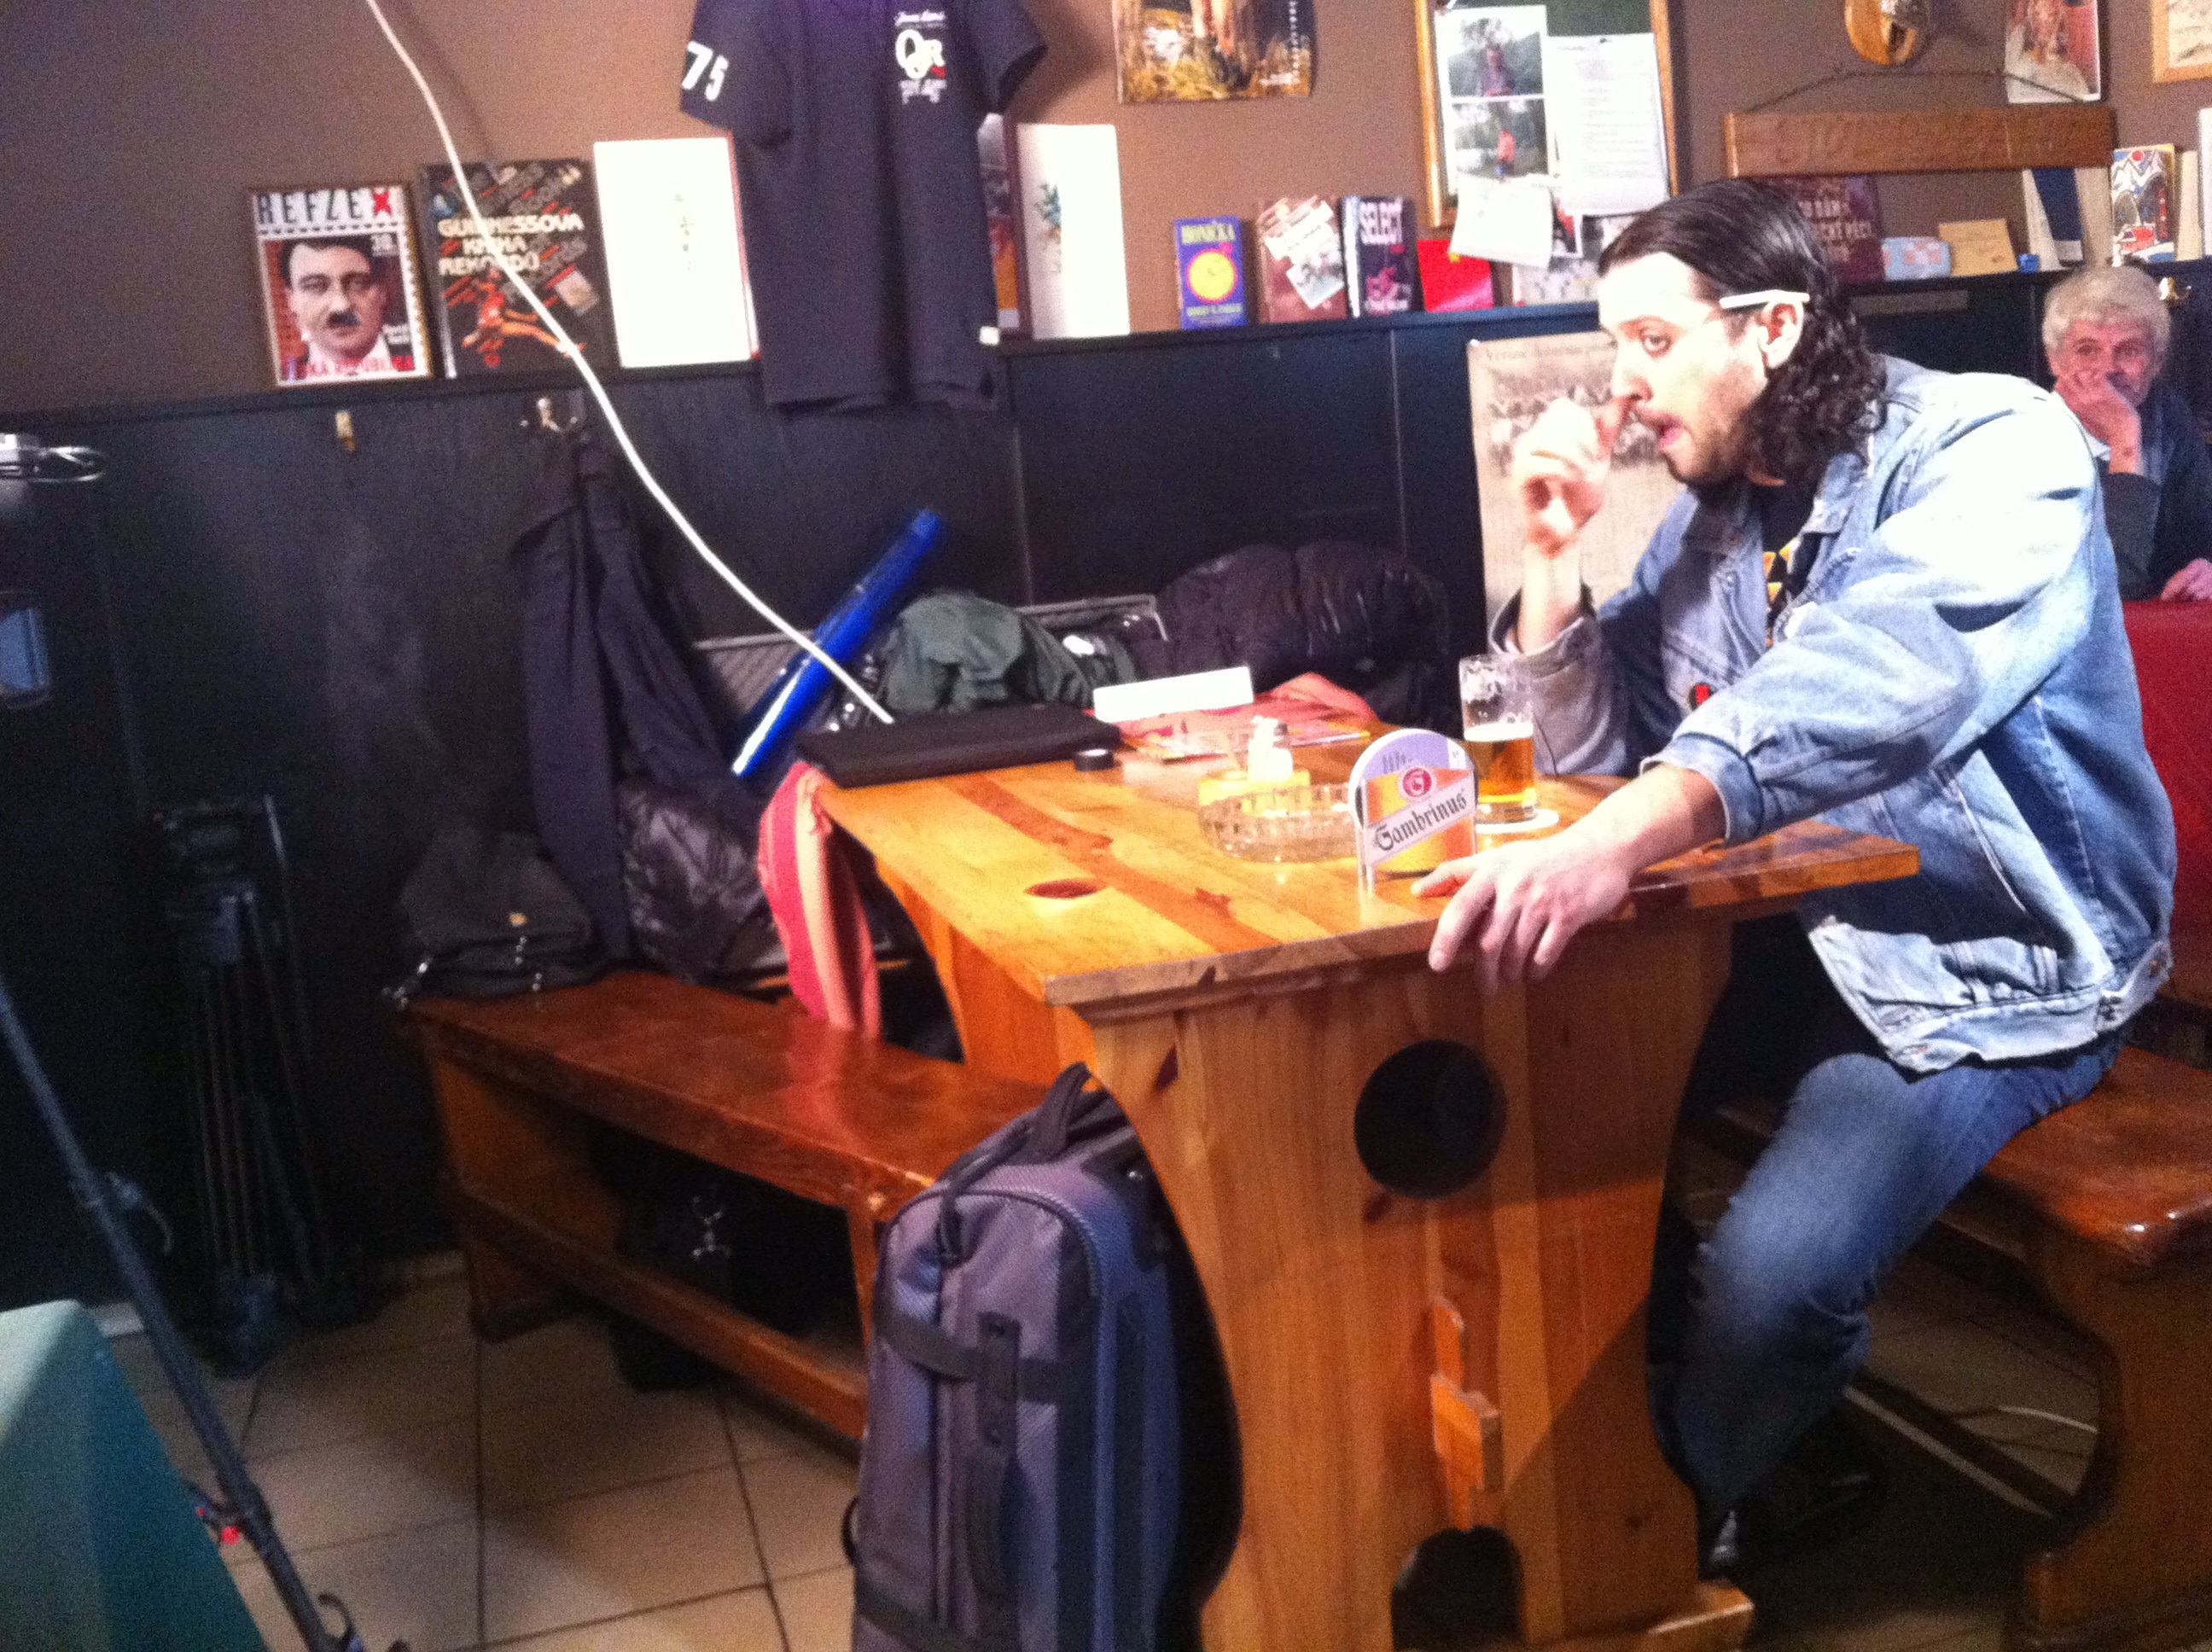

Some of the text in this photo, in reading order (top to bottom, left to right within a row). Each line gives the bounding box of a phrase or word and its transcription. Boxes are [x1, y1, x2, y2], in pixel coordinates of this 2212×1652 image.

[682, 40, 729, 101] 75
[437, 213, 585, 238] GUINESSOVA
[462, 236, 527, 255] KNHA
[438, 251, 540, 276] REKODŮ
[1374, 791, 1468, 852] Gambrinus
